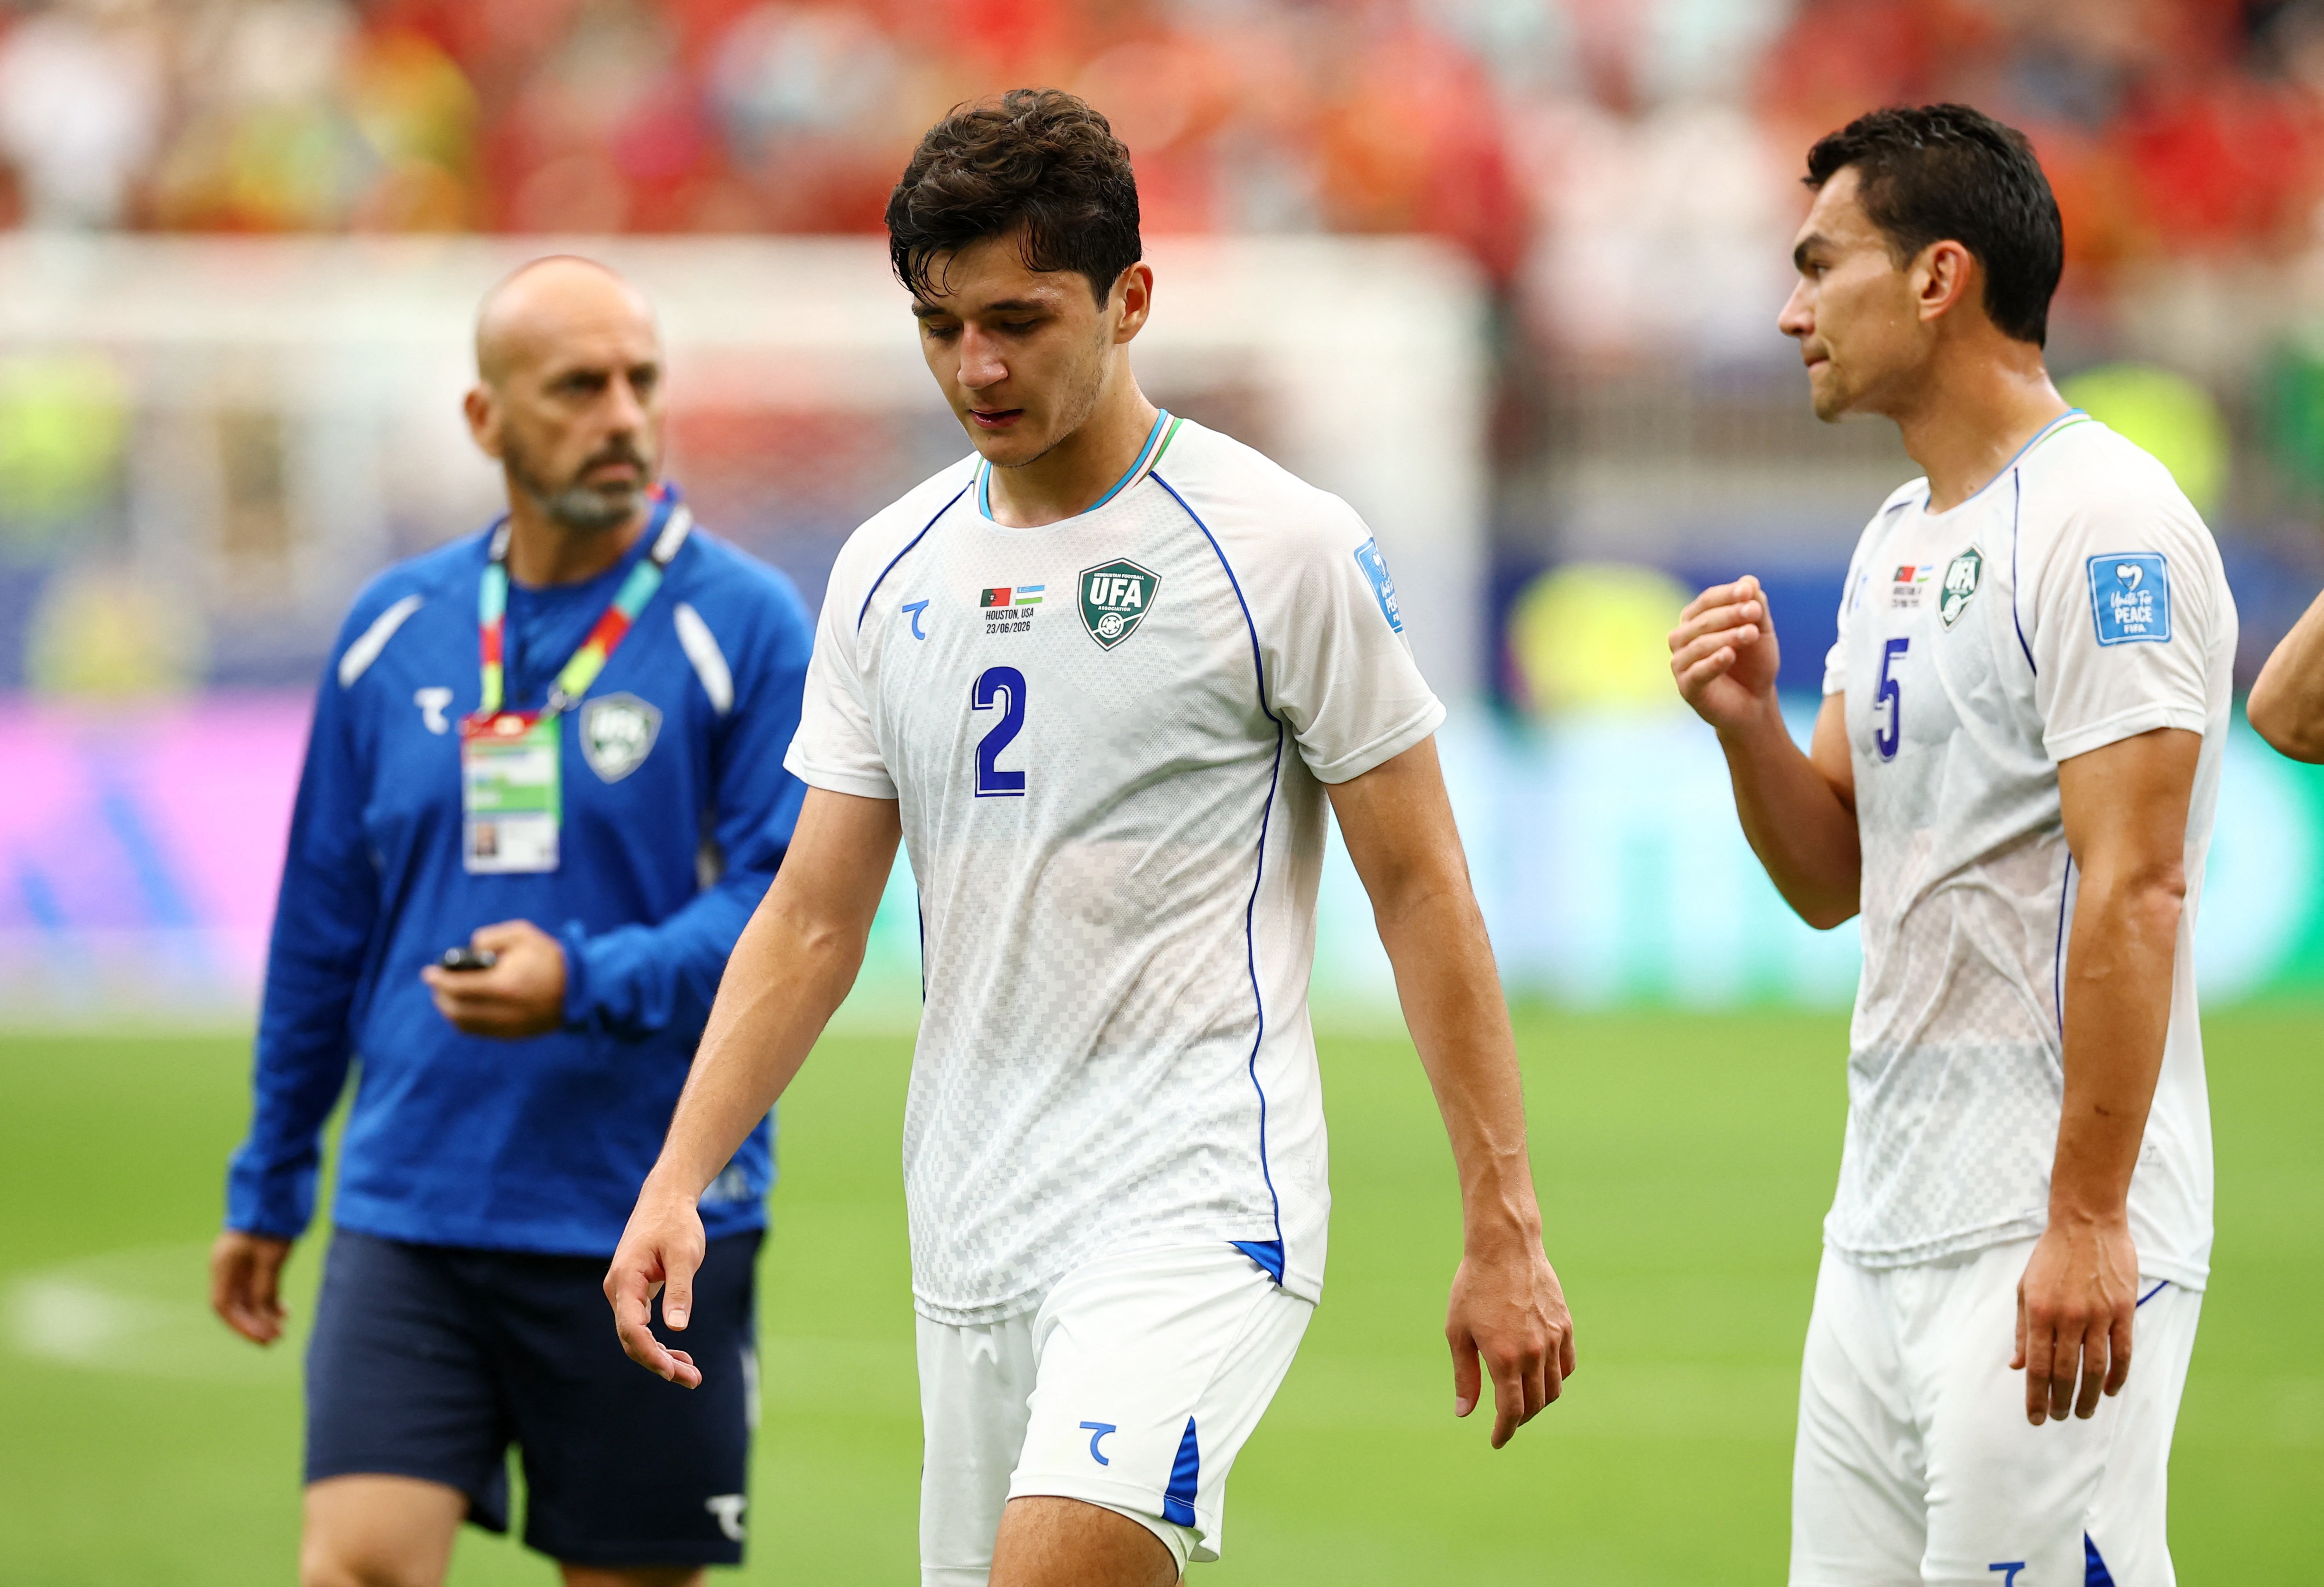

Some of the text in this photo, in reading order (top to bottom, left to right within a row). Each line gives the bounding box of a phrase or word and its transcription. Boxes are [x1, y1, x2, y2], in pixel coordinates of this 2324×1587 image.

[1945, 560, 1976, 591] UFA
[1089, 578, 1142, 608] UFA
[986, 608, 1034, 620] HOUSTON, USA
[2114, 606, 2153, 625] PEACE
[986, 621, 1030, 634] 23/06/2026
[2123, 623, 2147, 634] FIFA
[1874, 638, 1909, 763] 5
[972, 666, 1026, 798] 2
